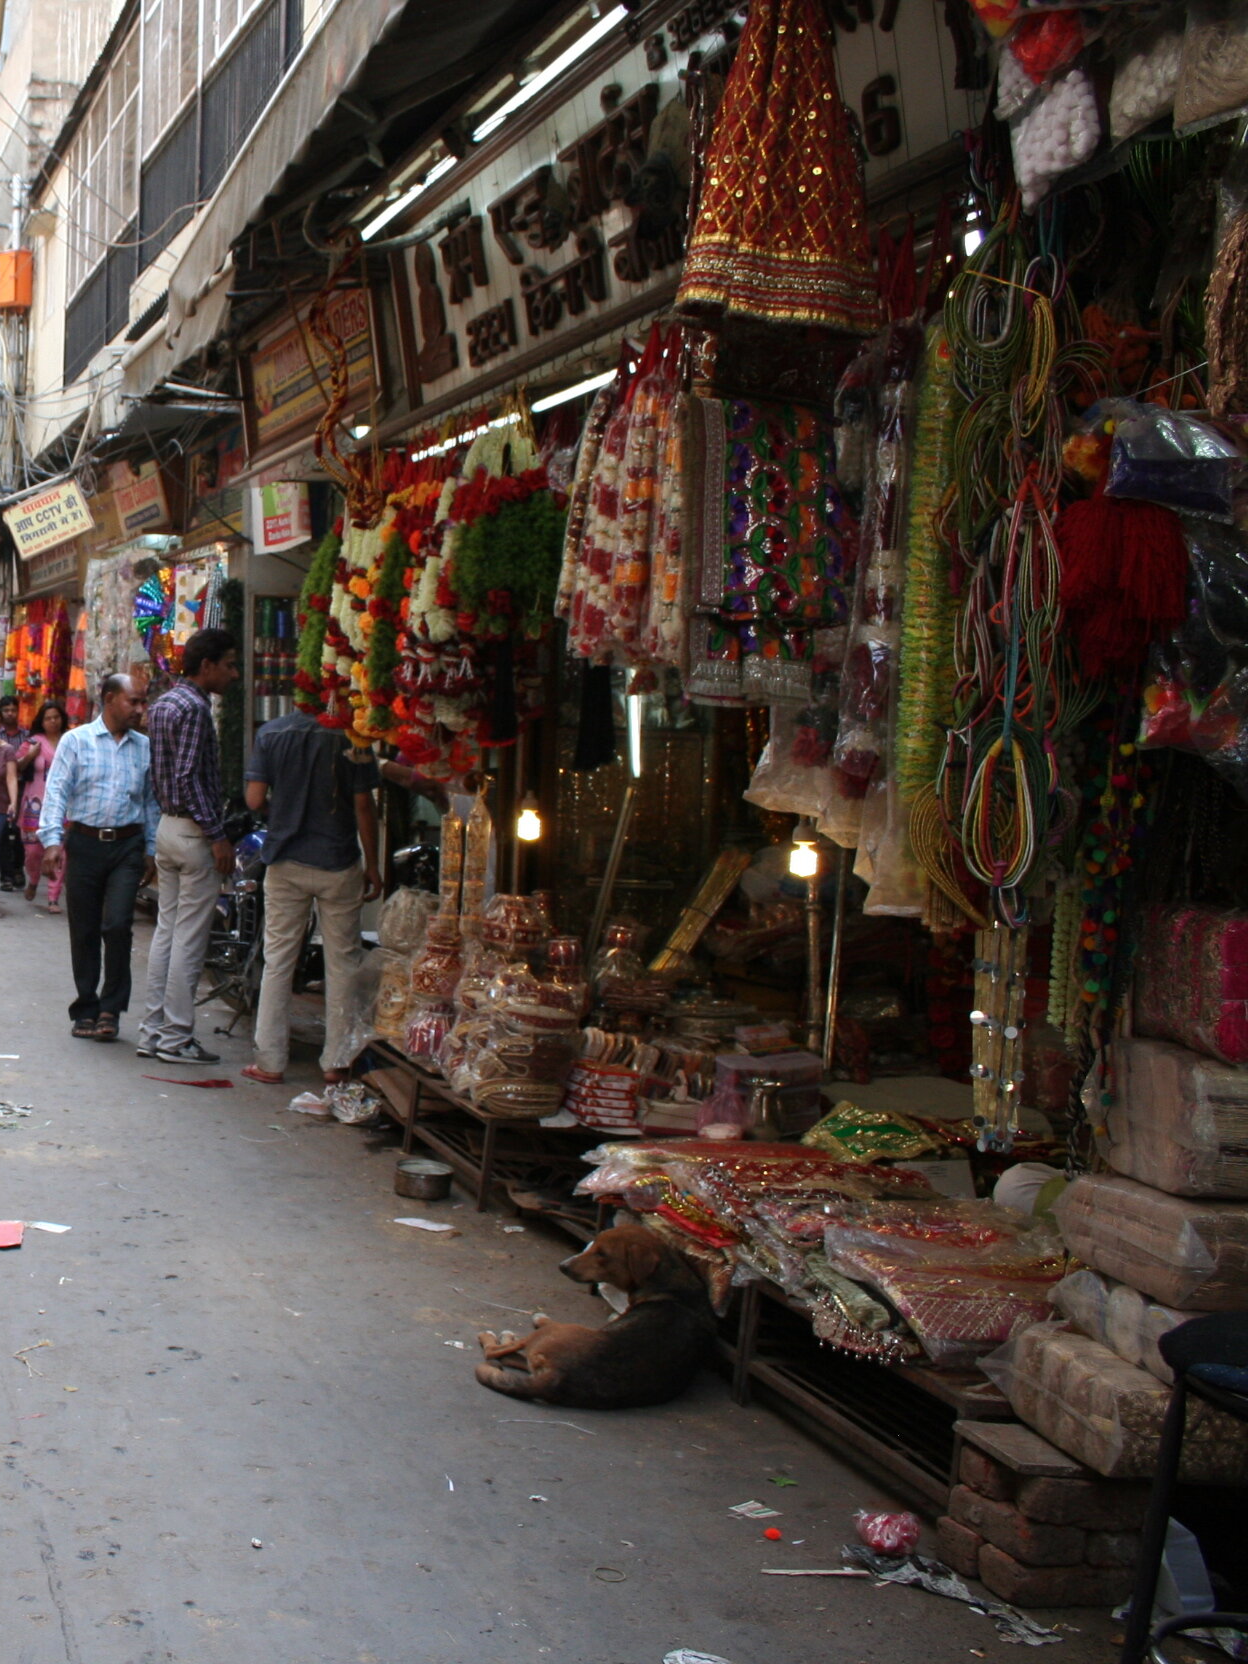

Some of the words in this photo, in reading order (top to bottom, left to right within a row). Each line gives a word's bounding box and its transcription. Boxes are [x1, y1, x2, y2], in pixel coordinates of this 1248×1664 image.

[861, 72, 902, 157] 6
[13, 516, 35, 534] आप
[35, 503, 63, 524] CCTV
[63, 494, 79, 510] की
